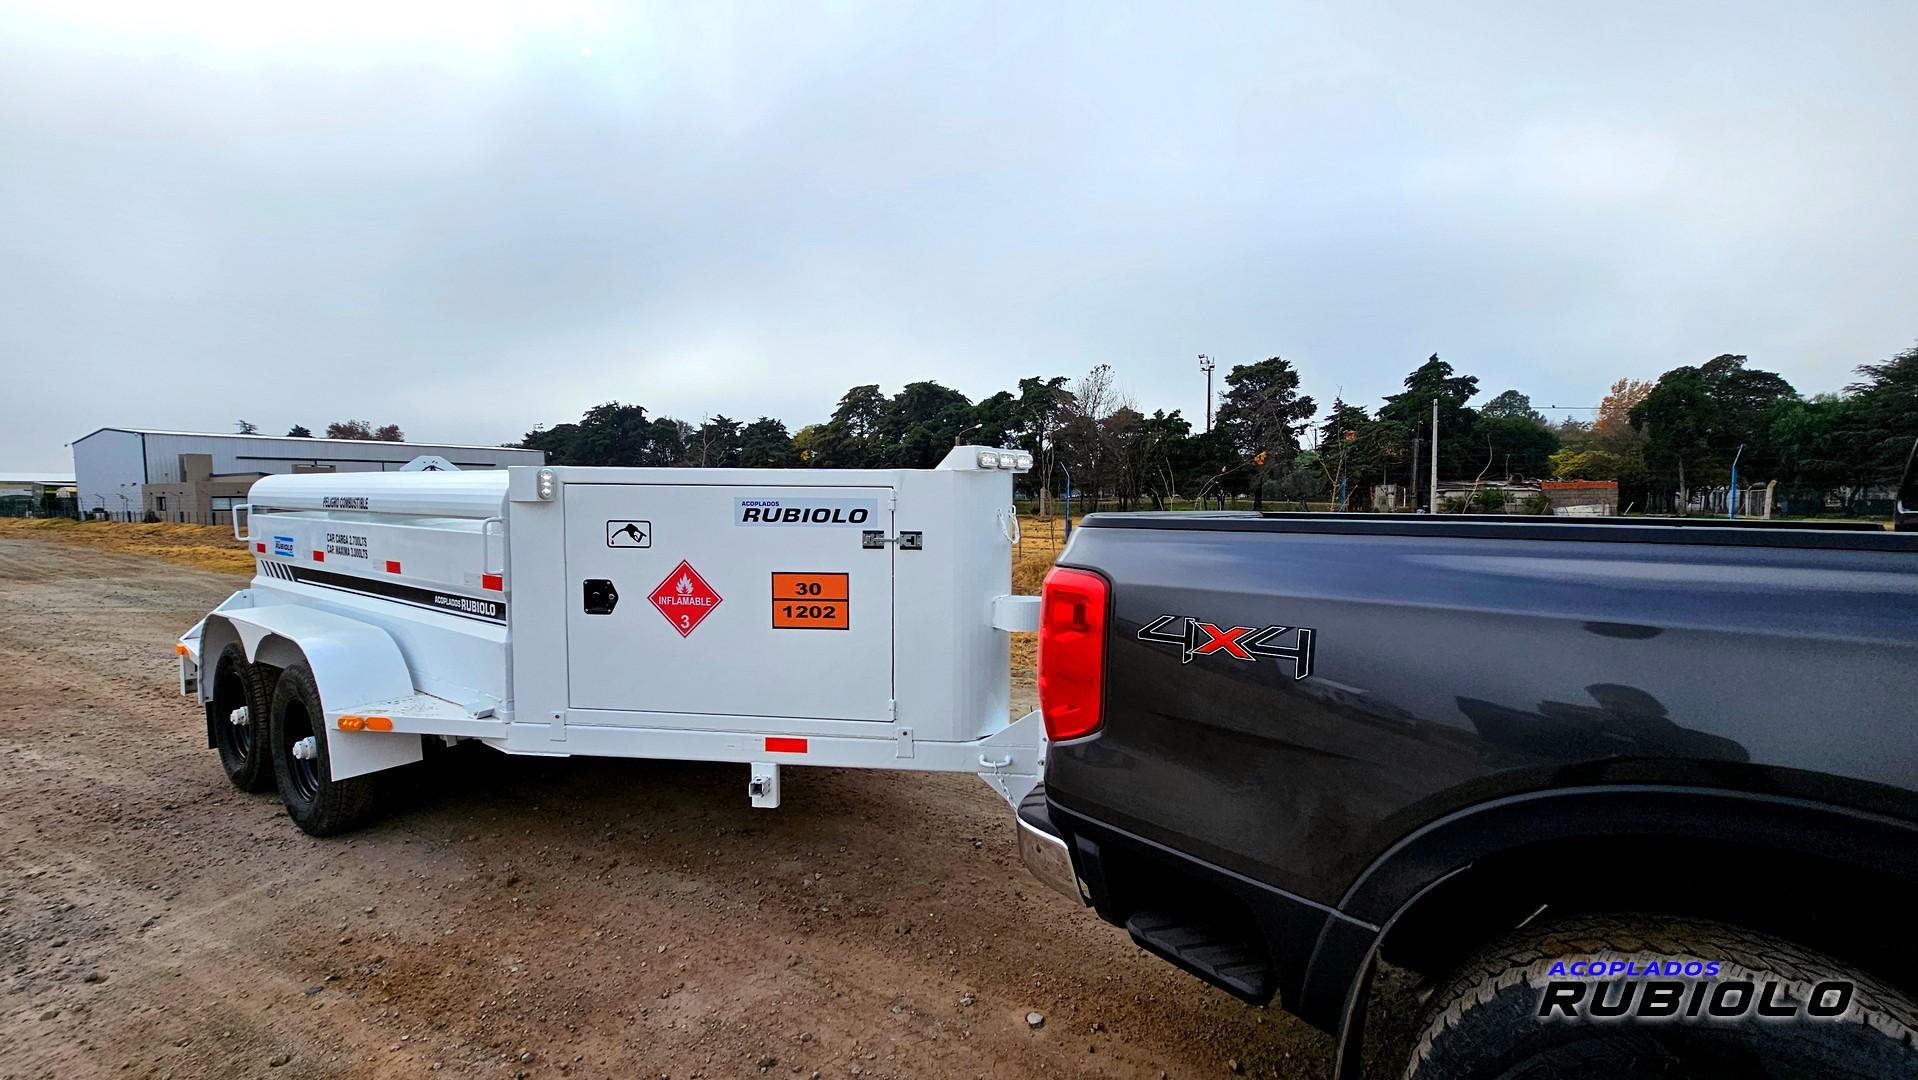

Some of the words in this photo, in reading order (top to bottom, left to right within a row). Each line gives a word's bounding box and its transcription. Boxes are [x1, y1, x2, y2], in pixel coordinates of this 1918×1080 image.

[742, 507, 869, 524] RUBIOLO
[794, 582, 823, 597] 30
[435, 596, 461, 607] ACOPLADOS
[461, 599, 496, 616] RUBIOLO
[658, 596, 712, 607] INFLAMABLE
[782, 605, 837, 619] 1202
[680, 614, 691, 629] 3
